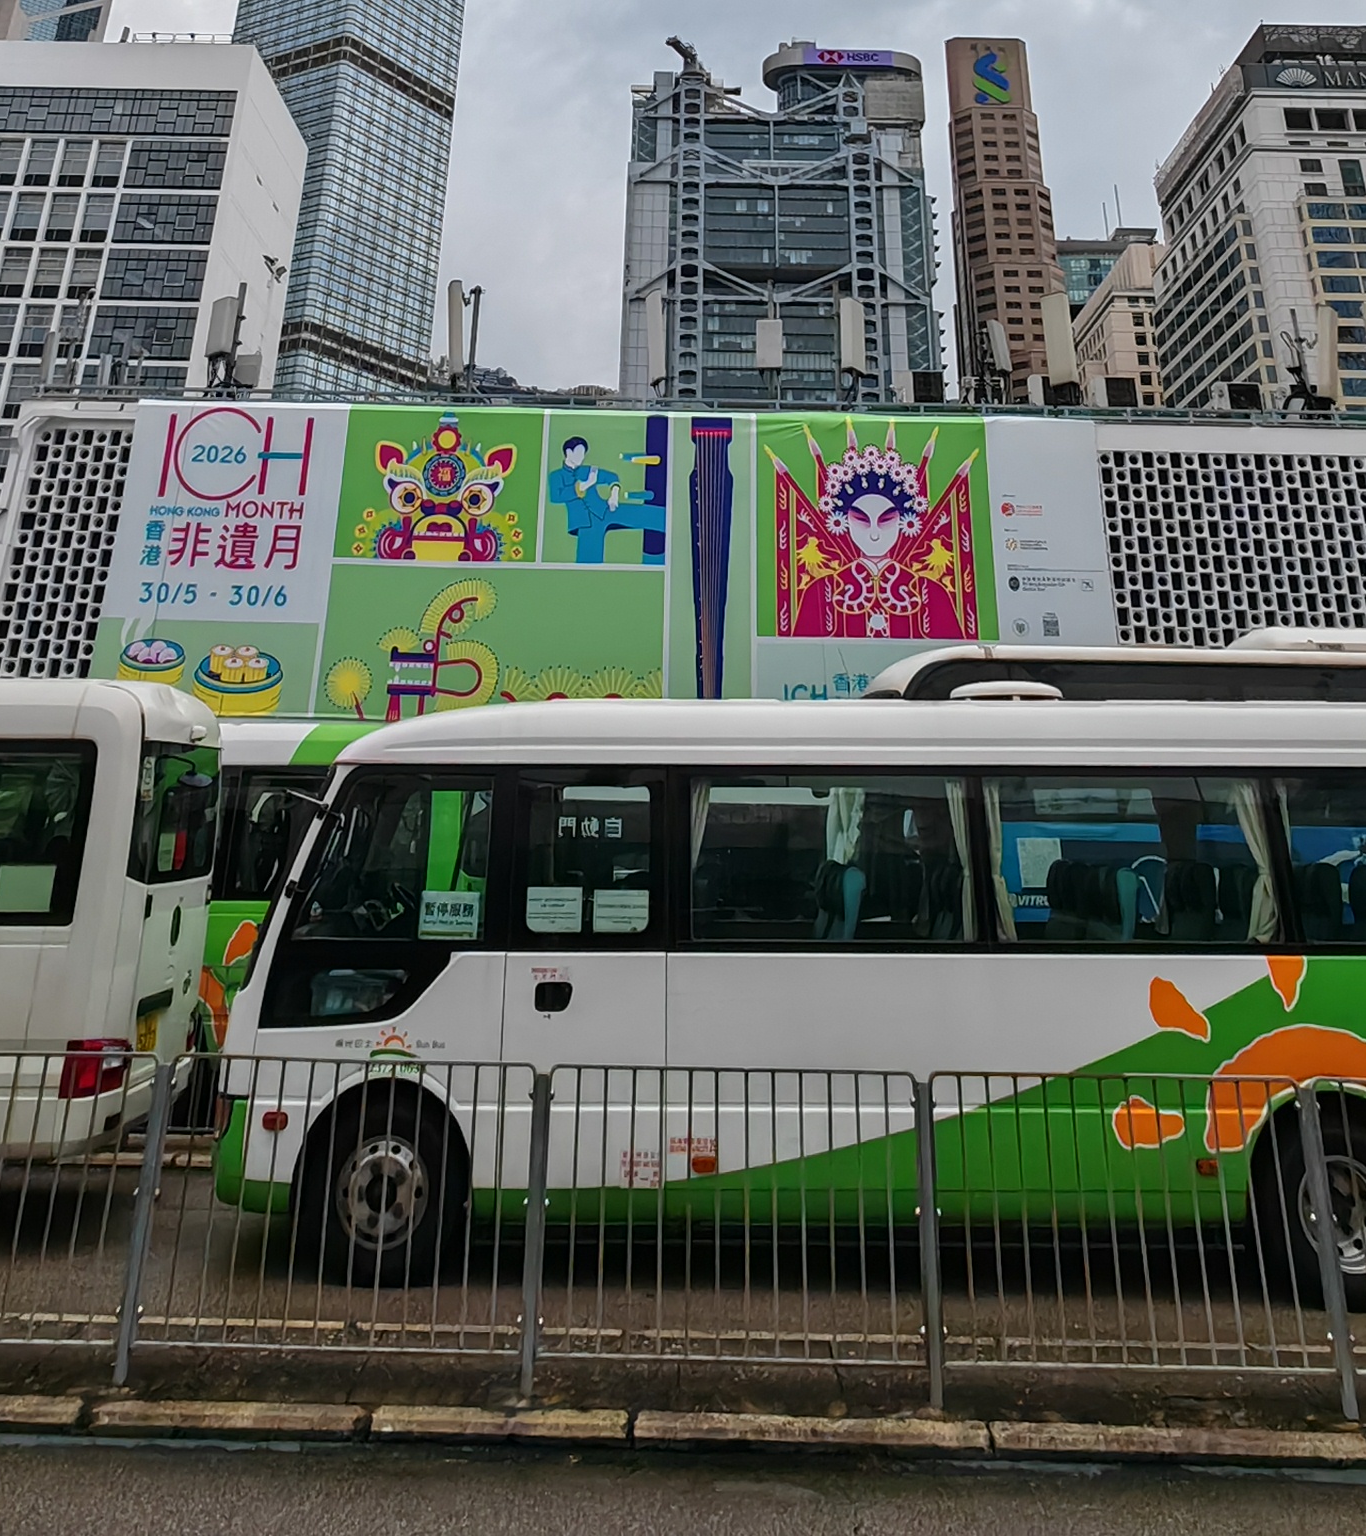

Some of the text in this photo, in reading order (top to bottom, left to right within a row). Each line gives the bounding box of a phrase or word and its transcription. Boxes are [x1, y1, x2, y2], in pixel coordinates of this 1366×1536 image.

[846, 52, 880, 62] HSBC
[191, 444, 247, 464] 2026
[149, 500, 305, 520] HONG KONG MONTH
[139, 519, 165, 566] 香港
[167, 521, 302, 570] 非遺月
[138, 581, 198, 604] 30/5
[228, 584, 288, 607] 30/6
